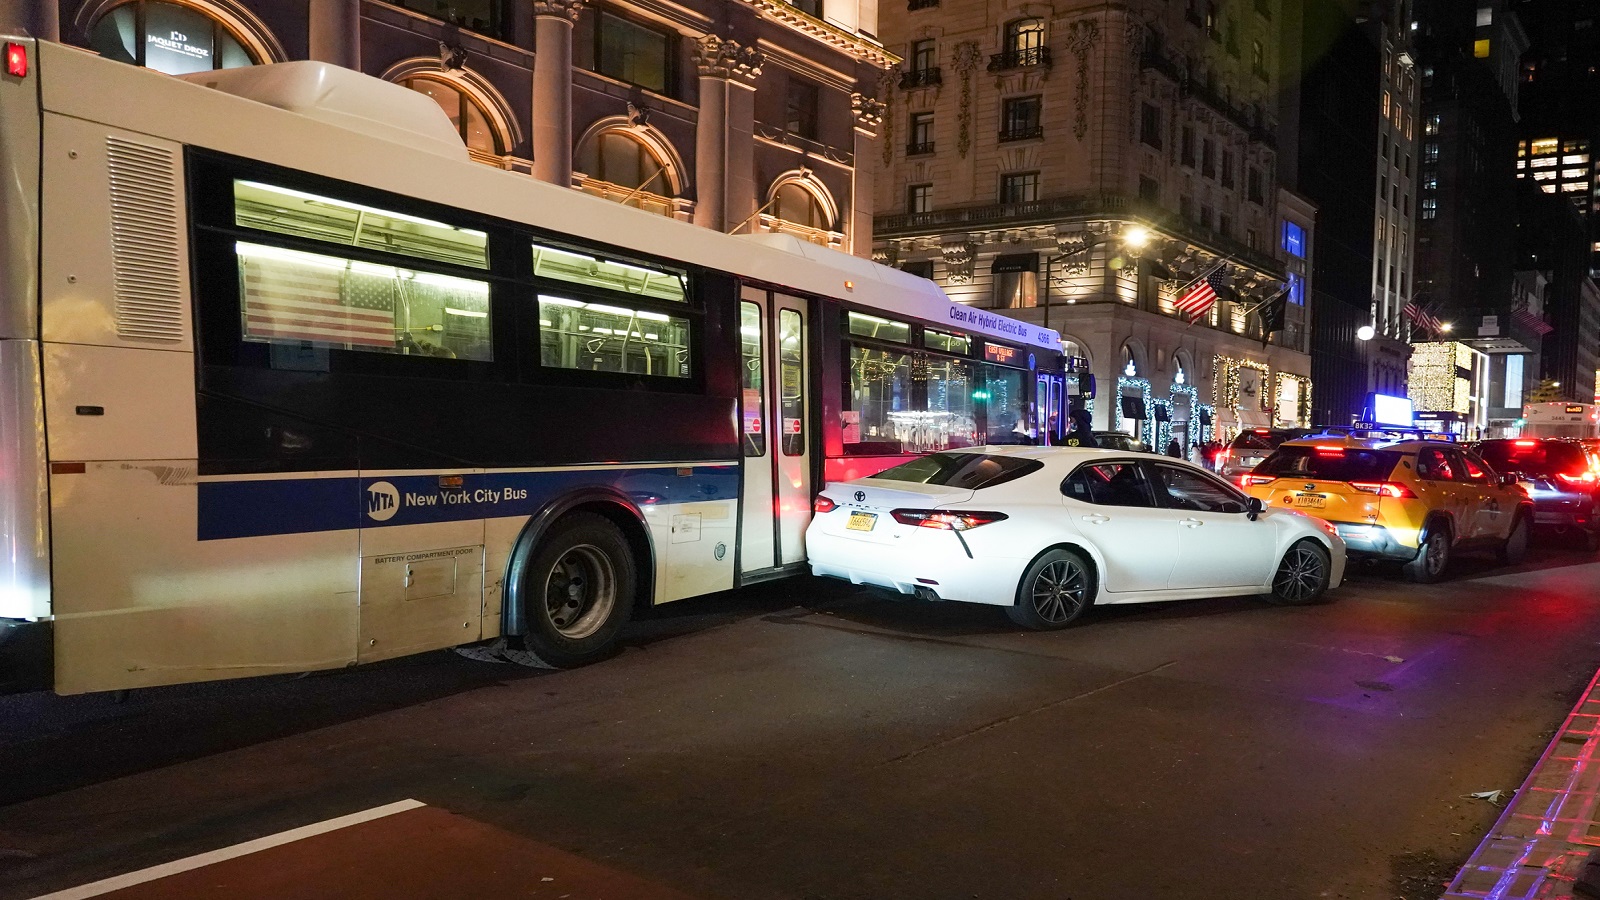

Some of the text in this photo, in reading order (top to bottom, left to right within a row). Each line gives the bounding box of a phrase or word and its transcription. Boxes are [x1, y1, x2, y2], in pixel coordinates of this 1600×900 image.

[148, 35, 183, 49] JAQUET
[184, 44, 209, 57] DROZ
[949, 306, 1028, 337] Clean Air Hybrid Electric Bus
[1037, 332, 1050, 344] 4366
[1354, 422, 1374, 430] 8K32
[368, 490, 395, 514] MTA
[406, 487, 528, 507] New York City Bus
[375, 548, 474, 565] BATTERY COMPARTMENT DOOR
